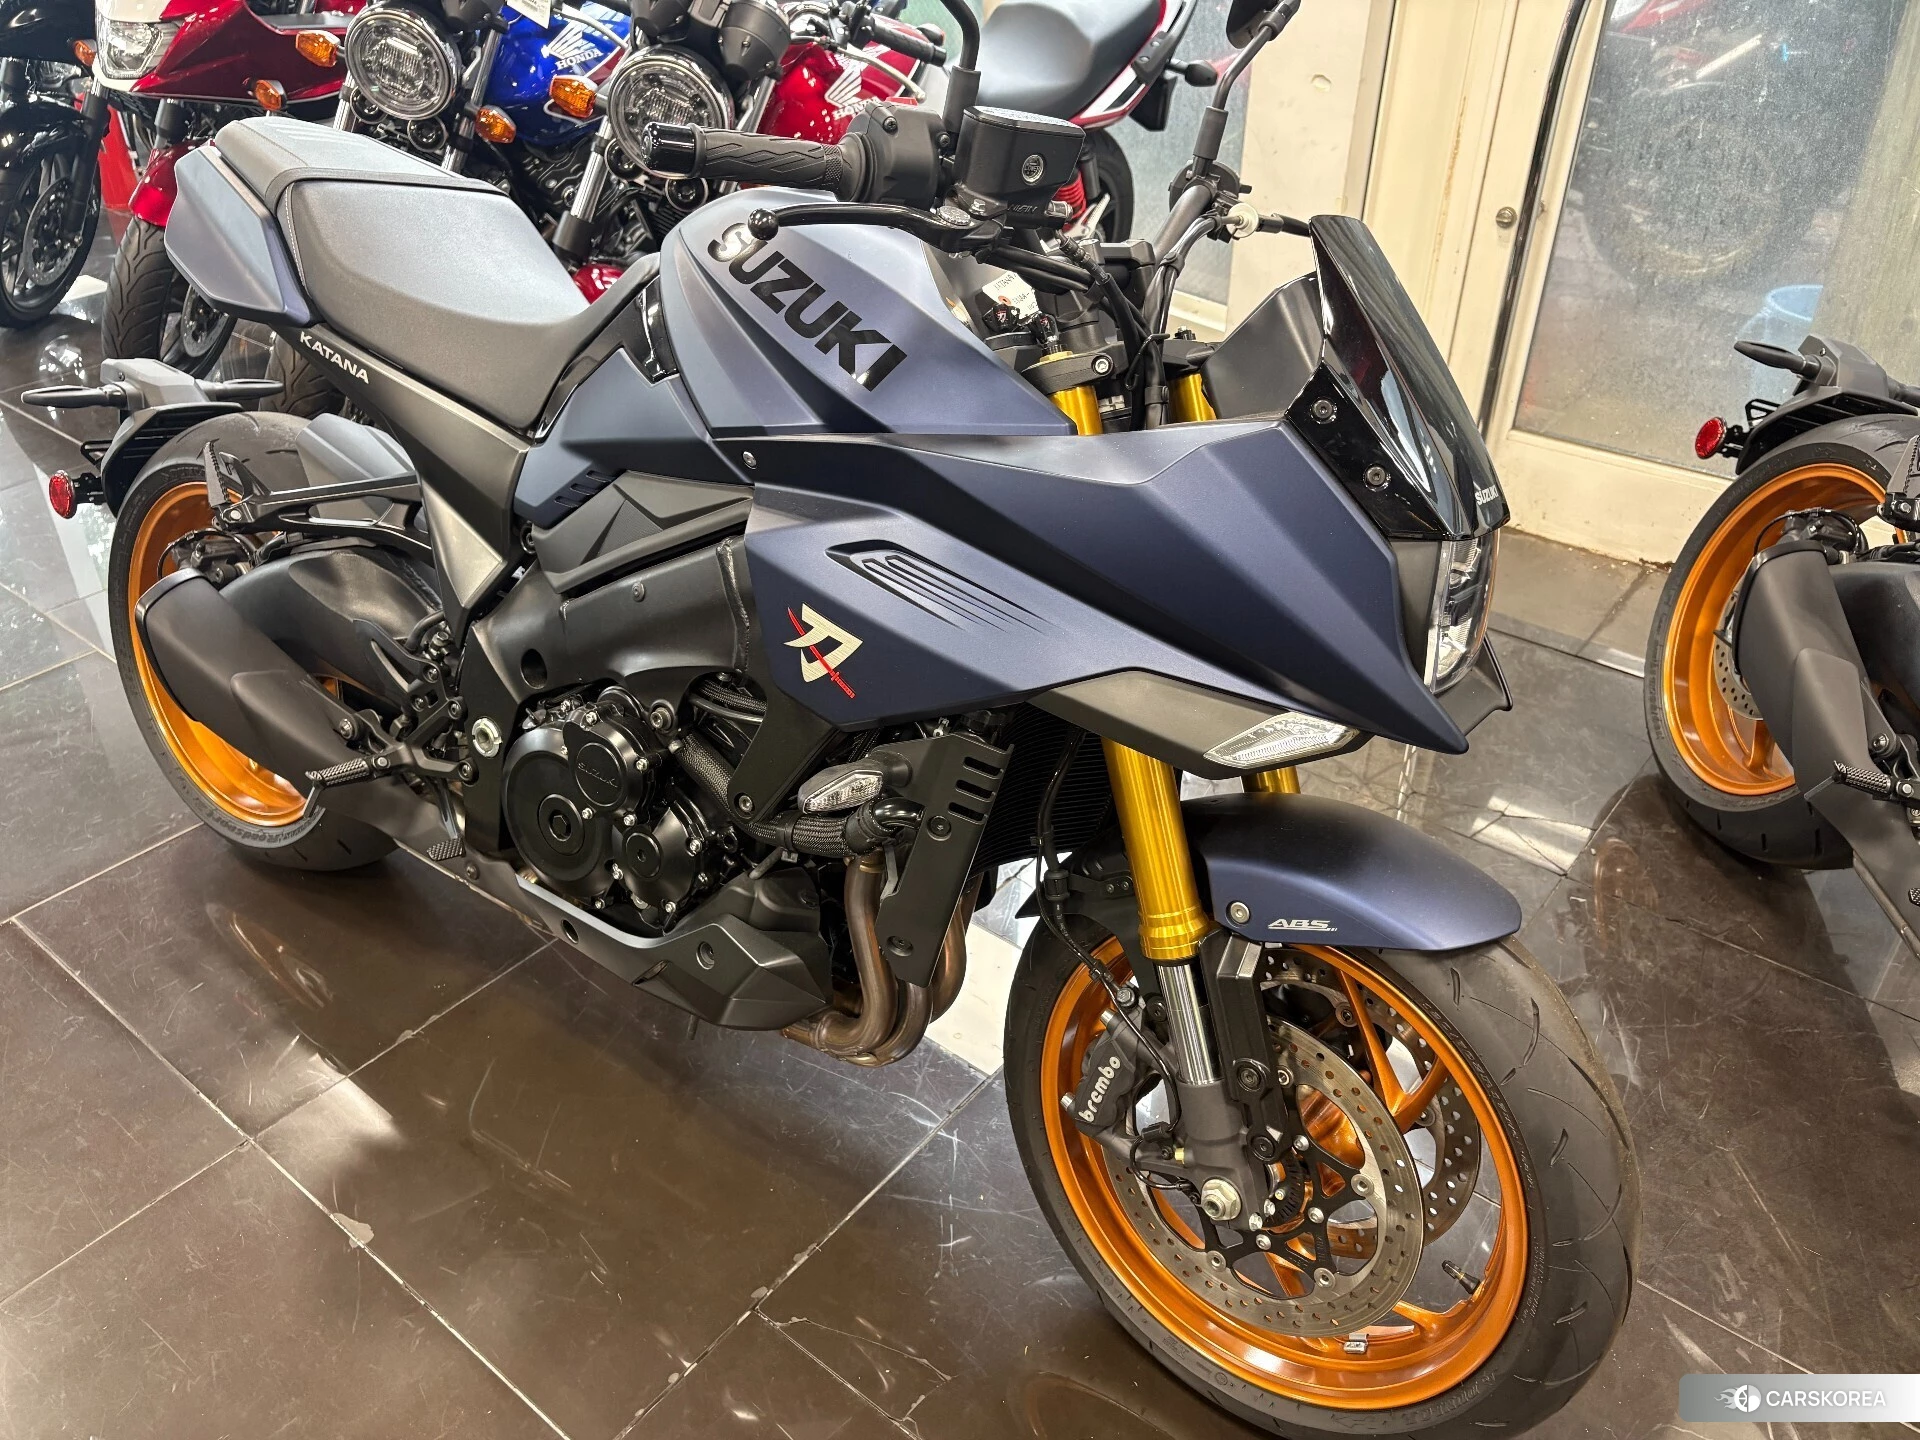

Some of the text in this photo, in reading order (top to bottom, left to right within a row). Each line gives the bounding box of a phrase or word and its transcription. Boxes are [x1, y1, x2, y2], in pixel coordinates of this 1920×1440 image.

[555, 48, 604, 71] HONDA
[707, 222, 908, 392] SUZUKI
[300, 330, 369, 385] KATANA
[1267, 918, 1332, 930] ABS
[1078, 1056, 1121, 1123] brembo
